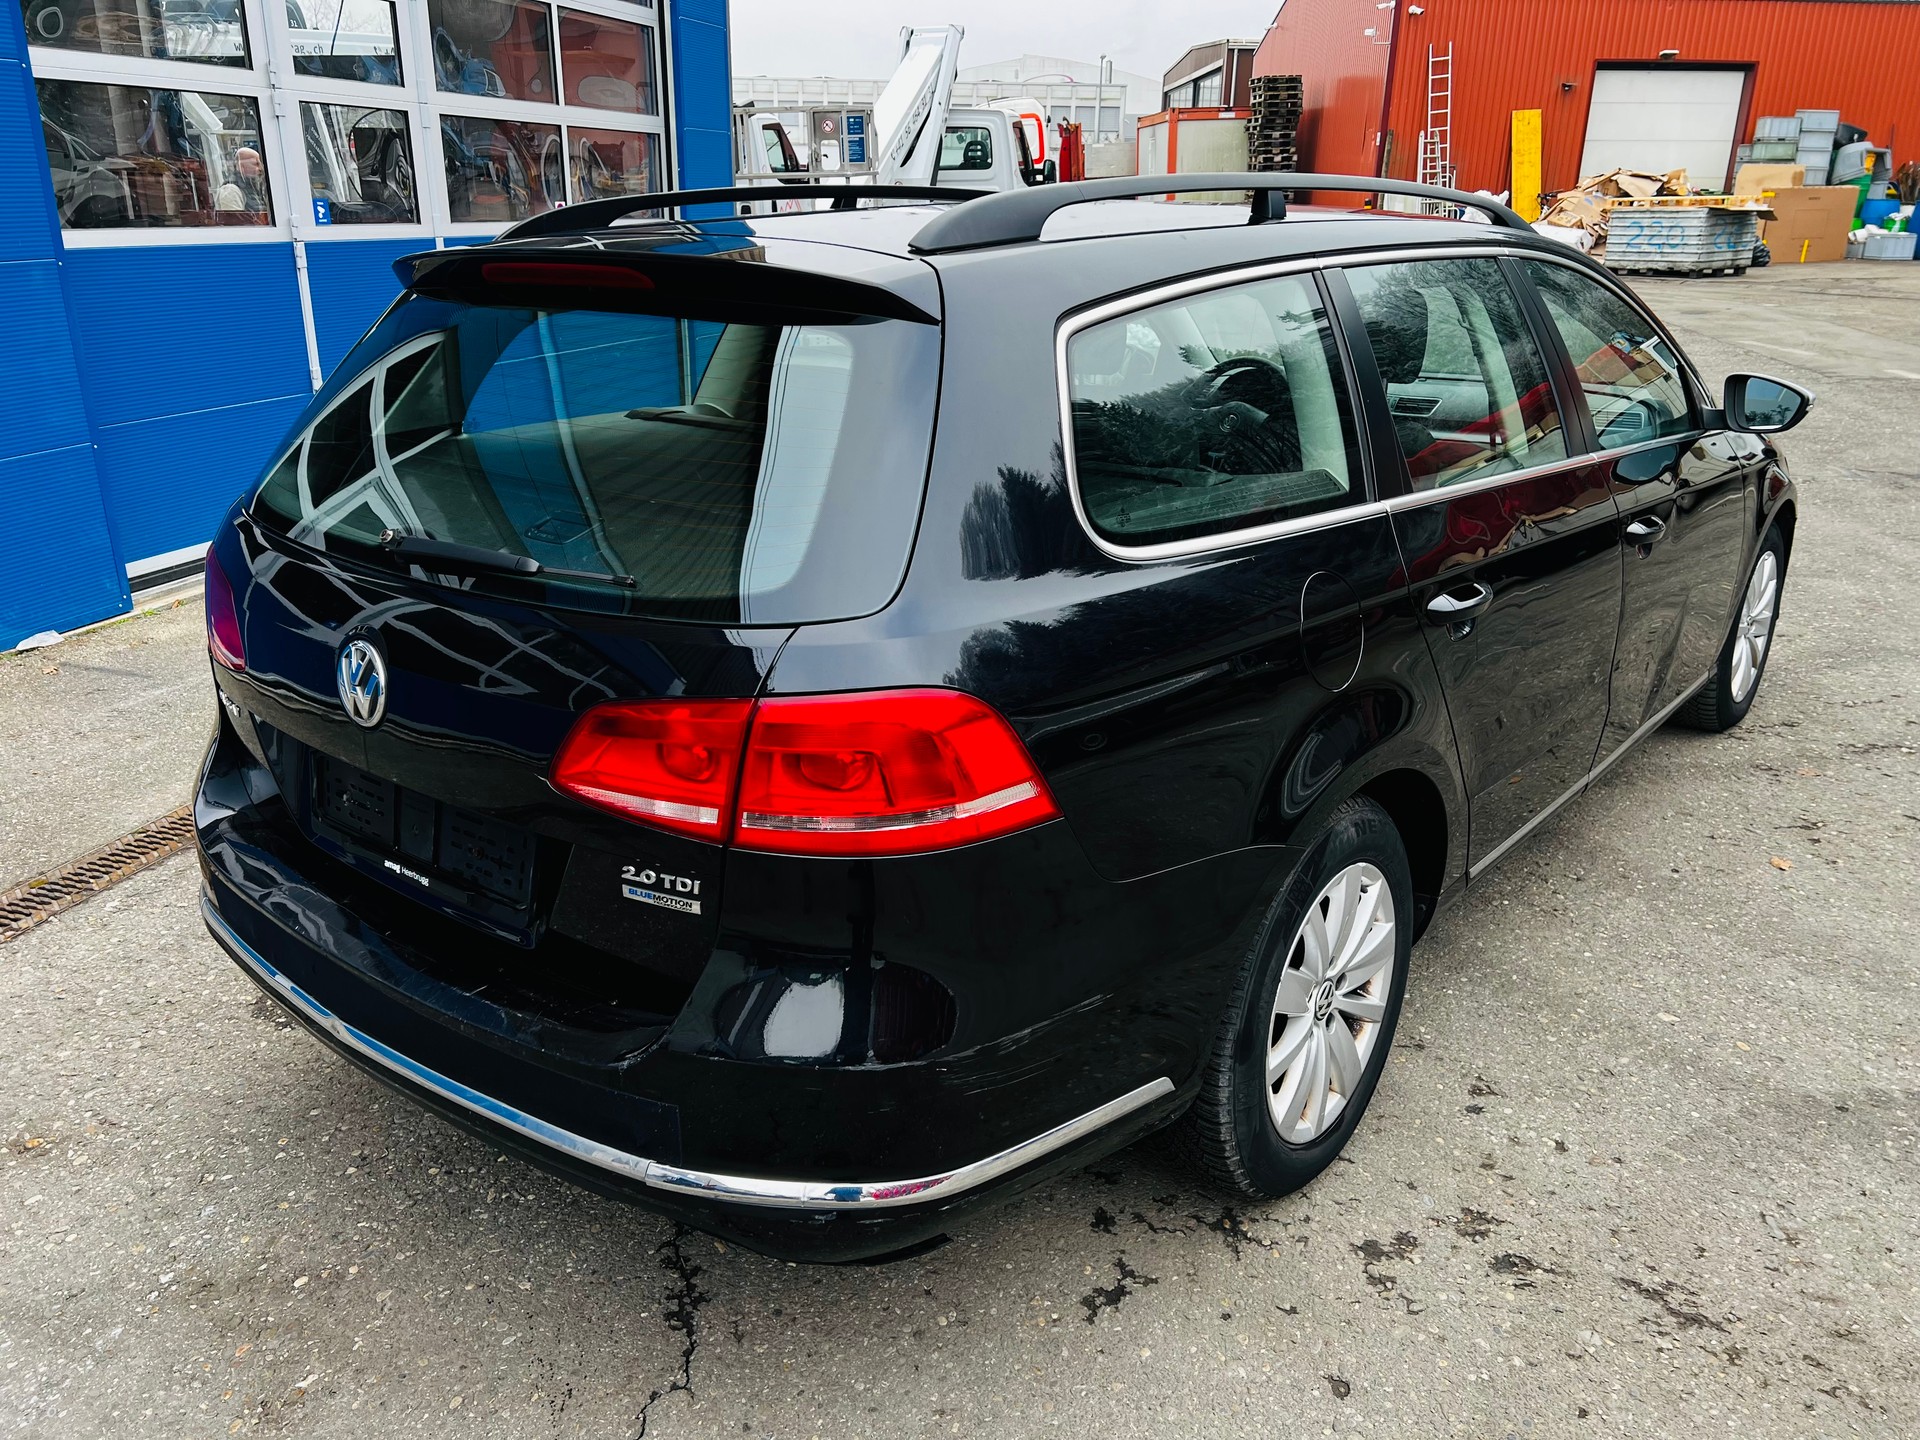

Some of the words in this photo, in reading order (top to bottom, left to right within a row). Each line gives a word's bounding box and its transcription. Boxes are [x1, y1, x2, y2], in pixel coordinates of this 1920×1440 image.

[384, 859, 401, 874] amag
[660, 873, 701, 895] TDI
[628, 887, 693, 909] BLUEMOTION
